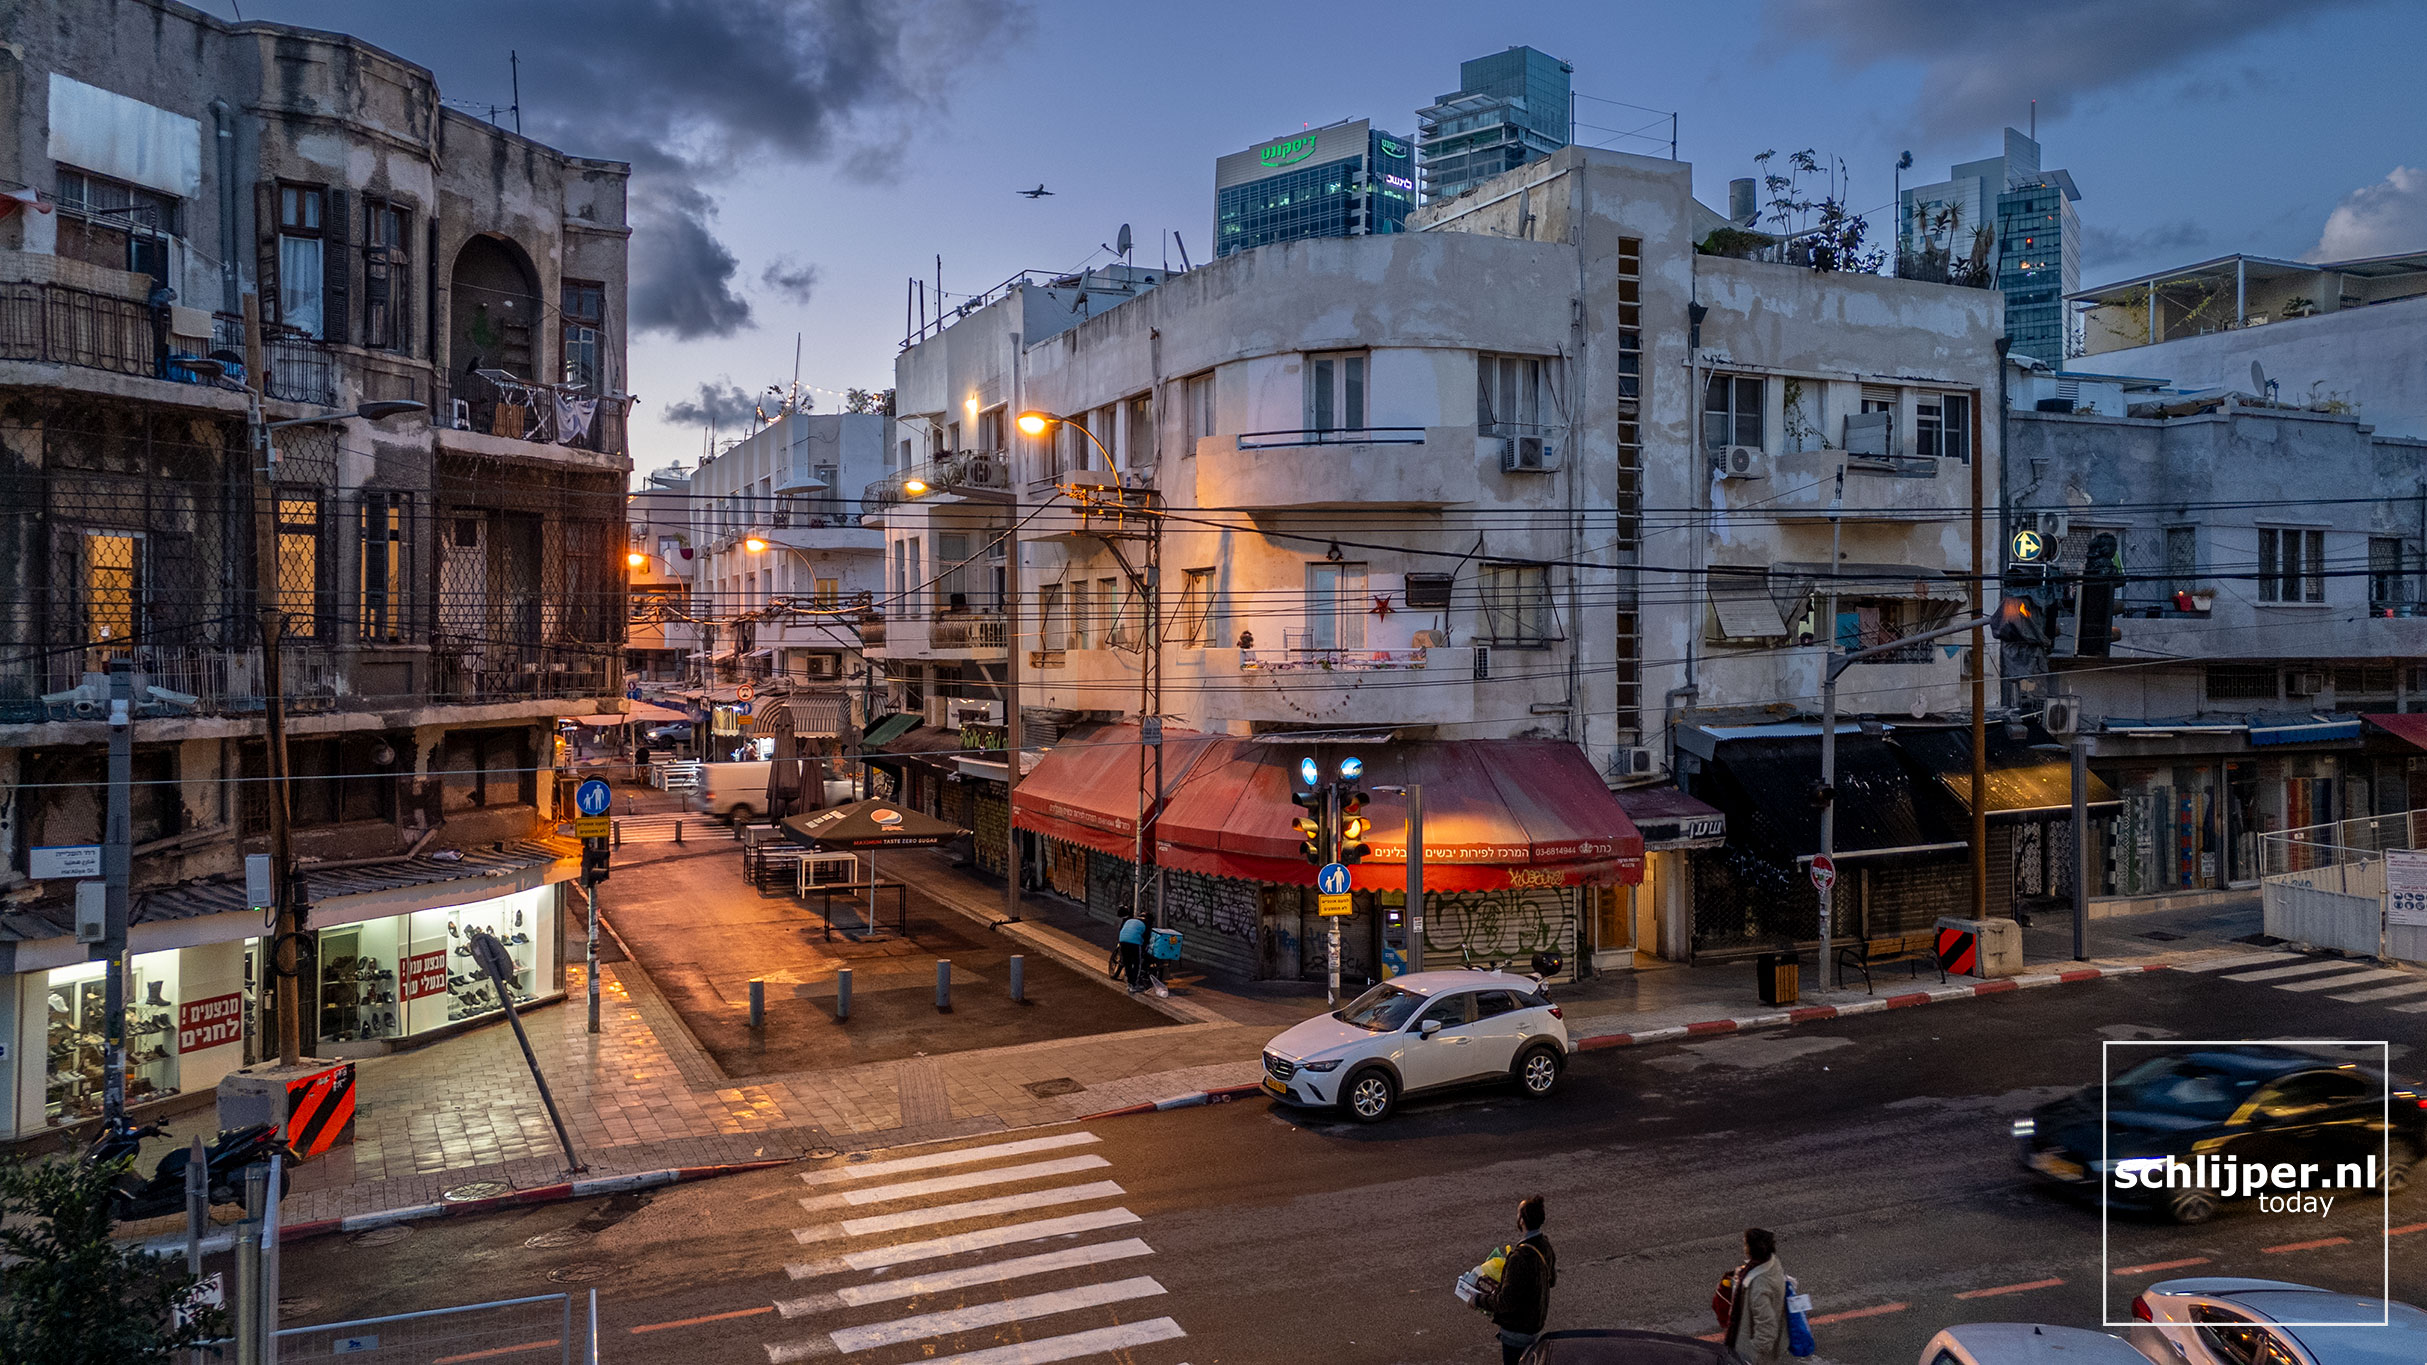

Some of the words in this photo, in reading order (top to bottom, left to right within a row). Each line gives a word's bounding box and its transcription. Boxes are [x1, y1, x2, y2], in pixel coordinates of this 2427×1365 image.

[1261, 136, 1316, 160] דיסקונט
[1690, 821, 1722, 839] שען
[1375, 846, 1407, 858] בלינים
[1425, 848, 1457, 858] יבשים
[1460, 846, 1494, 858] לפירות
[1497, 848, 1529, 858] המרכז
[1594, 844, 1612, 854] כתר
[424, 954, 445, 972] מבצע
[402, 980, 419, 997] ער
[420, 973, 446, 992] בנעלי
[191, 998, 239, 1023] מבצעים
[181, 1017, 240, 1049] לחגים
